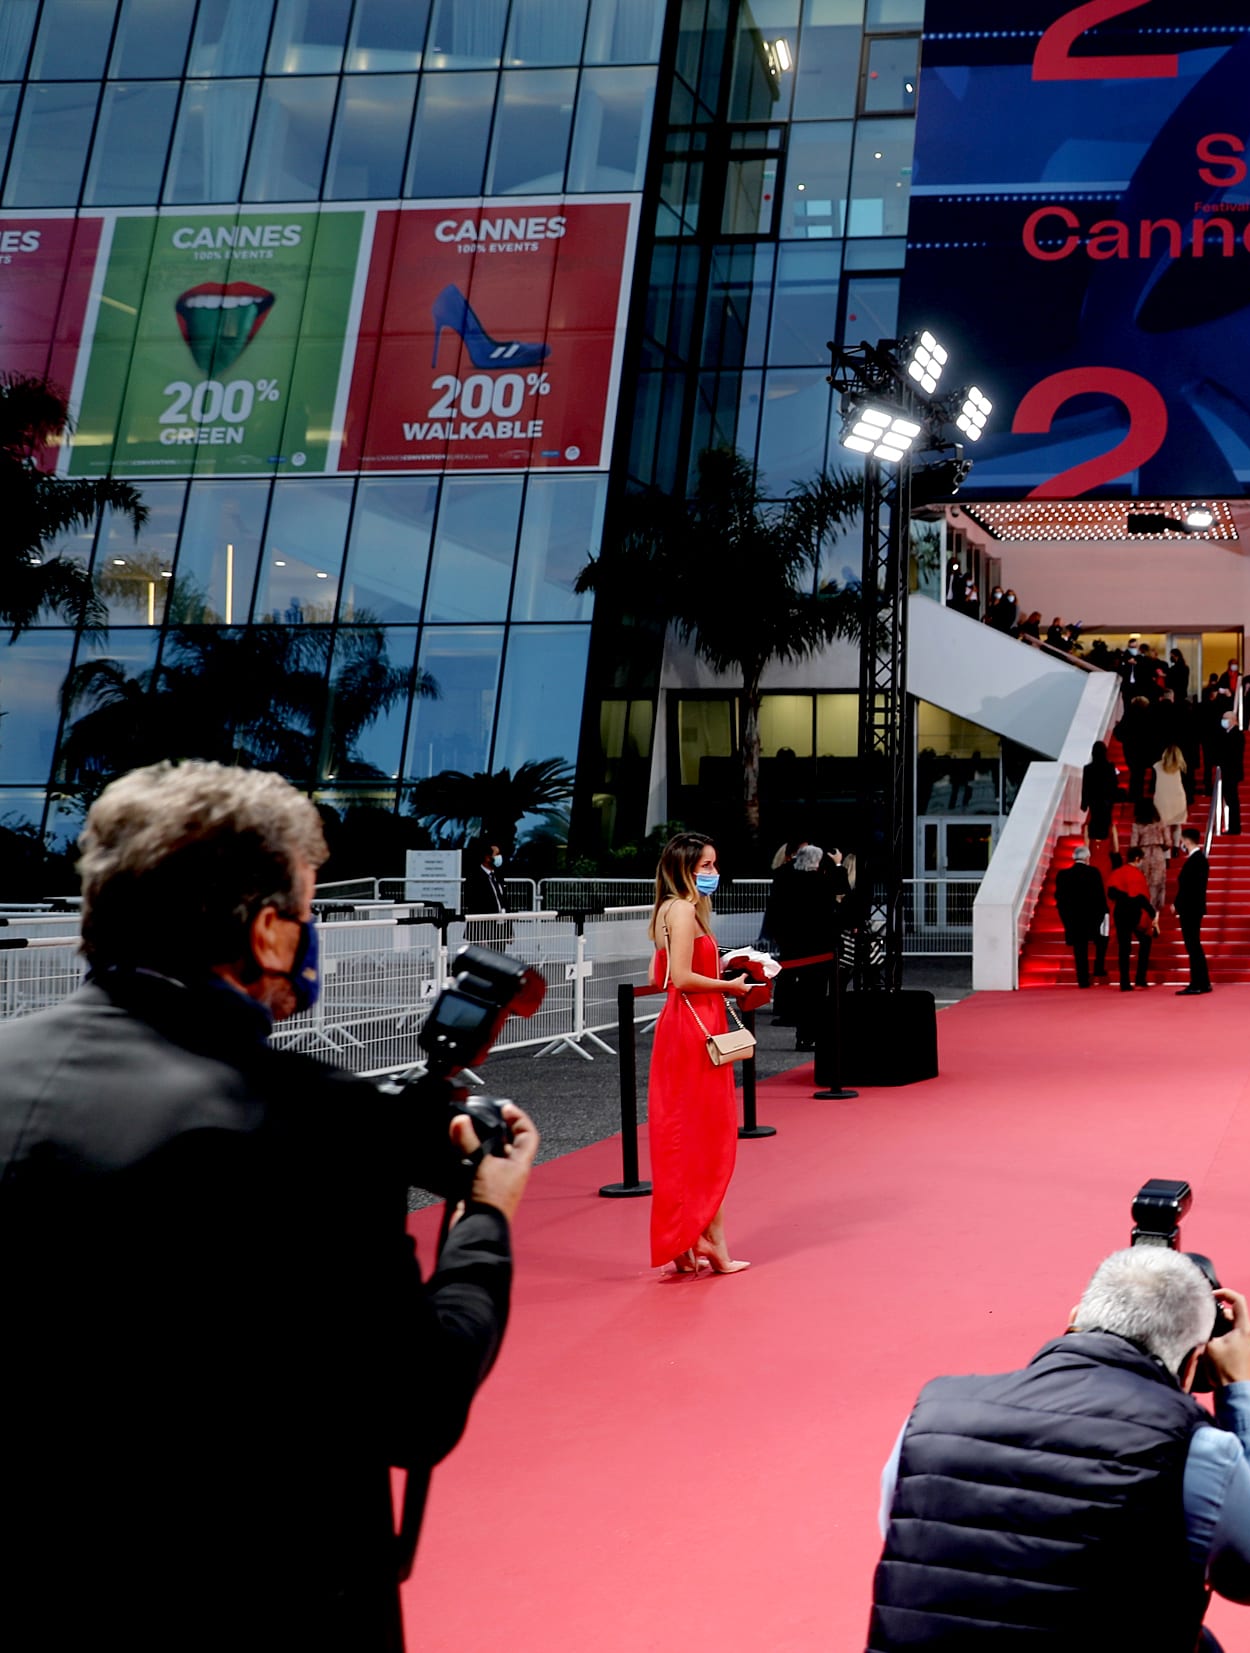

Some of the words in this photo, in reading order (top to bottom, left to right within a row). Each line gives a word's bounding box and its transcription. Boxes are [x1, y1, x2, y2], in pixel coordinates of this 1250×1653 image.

[1193, 201, 1250, 212] Festival
[172, 224, 303, 249] CANNES
[434, 215, 567, 243] CANNES
[0, 229, 41, 253] ES
[457, 243, 486, 254] 100%
[488, 241, 539, 253] EVENTS
[225, 249, 274, 259] EVENTS
[158, 378, 280, 424] 200%
[427, 372, 551, 419] 200%
[159, 427, 244, 445] GREEN
[402, 420, 544, 441] WALKABLE
